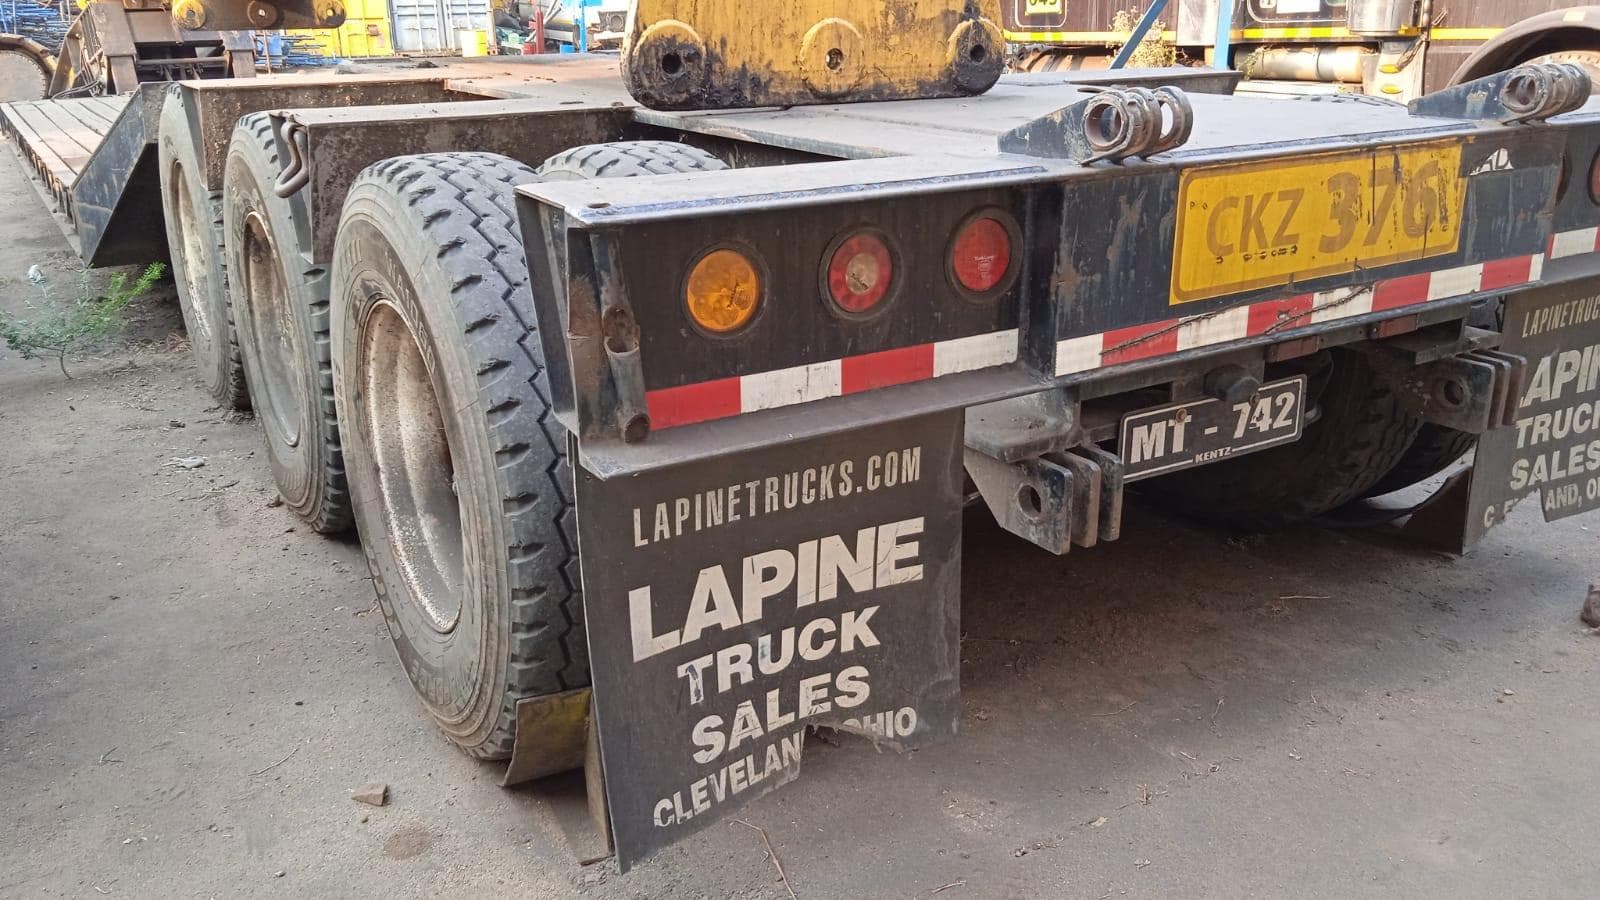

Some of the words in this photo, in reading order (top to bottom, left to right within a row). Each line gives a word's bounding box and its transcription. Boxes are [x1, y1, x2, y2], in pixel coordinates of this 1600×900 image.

[1206, 188, 1305, 257] CKZ
[1318, 160, 1440, 254] 376
[1522, 295, 1600, 338] LAPINETRUC
[1519, 344, 1600, 409] API
[1130, 415, 1192, 464] MT
[1232, 391, 1296, 439] 742
[1195, 446, 1233, 463] KENTZ
[1510, 440, 1600, 490] SALES
[633, 446, 921, 547] LAPINETRUCKS.COM
[628, 517, 925, 663] LAPINE
[677, 606, 881, 705] TRUCK
[692, 666, 870, 764] SALES
[653, 728, 806, 828] CLEVELAN
